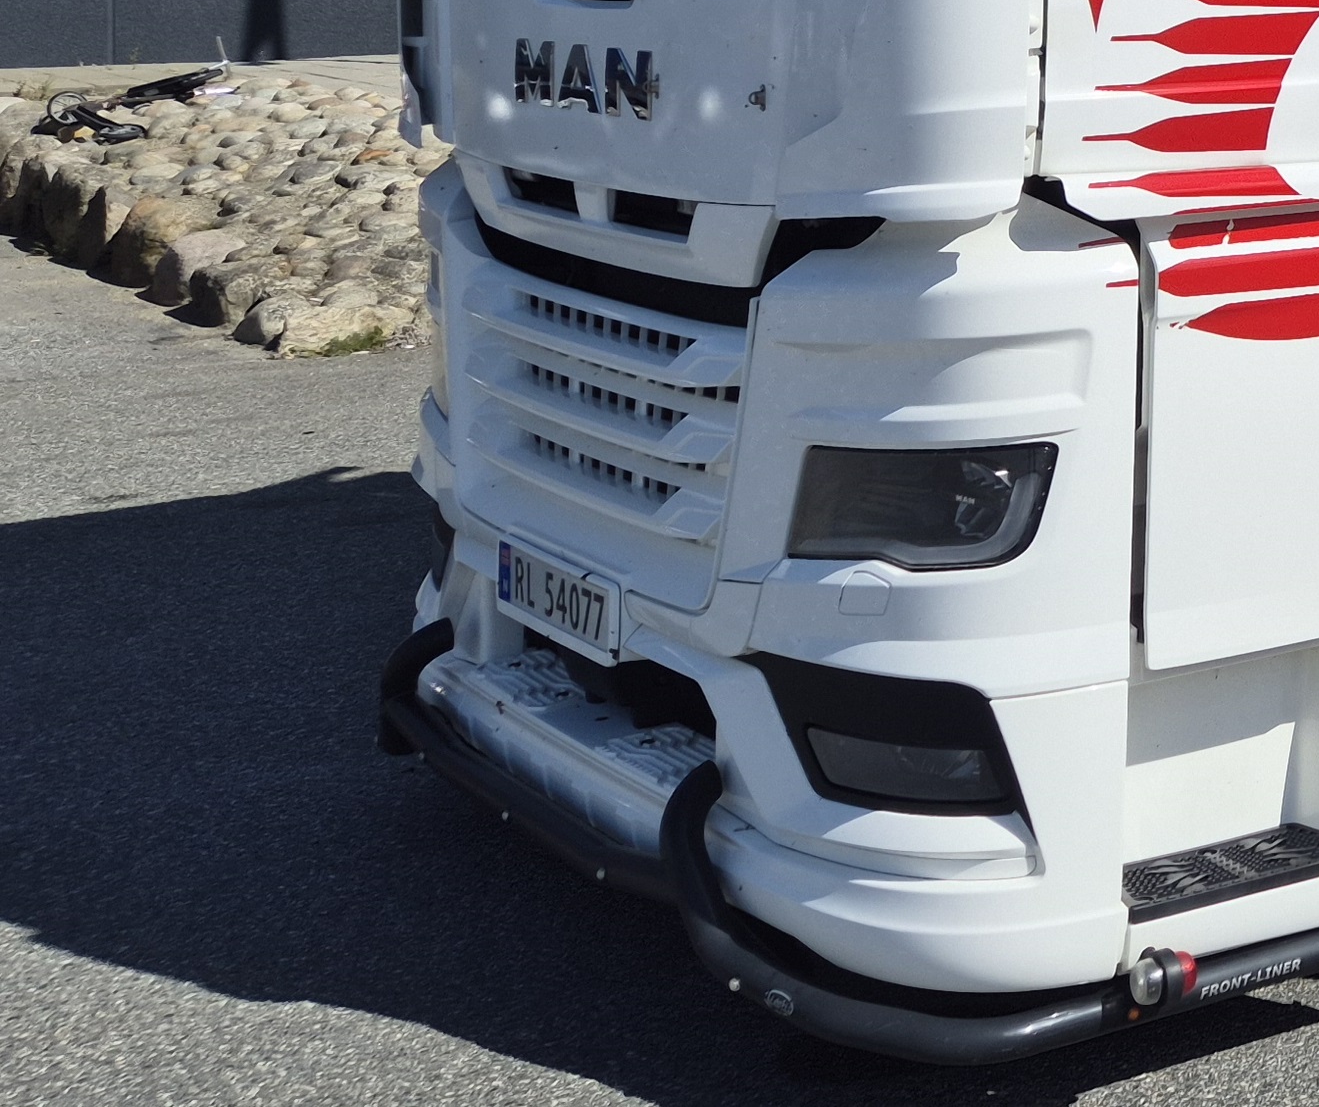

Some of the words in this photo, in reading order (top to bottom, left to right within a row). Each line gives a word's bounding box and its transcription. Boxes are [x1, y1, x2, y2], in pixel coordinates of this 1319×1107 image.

[514, 37, 654, 122] MAN
[514, 556, 535, 609] RL
[544, 571, 605, 641] 54077
[1199, 958, 1302, 1001] FRONT-LINER
